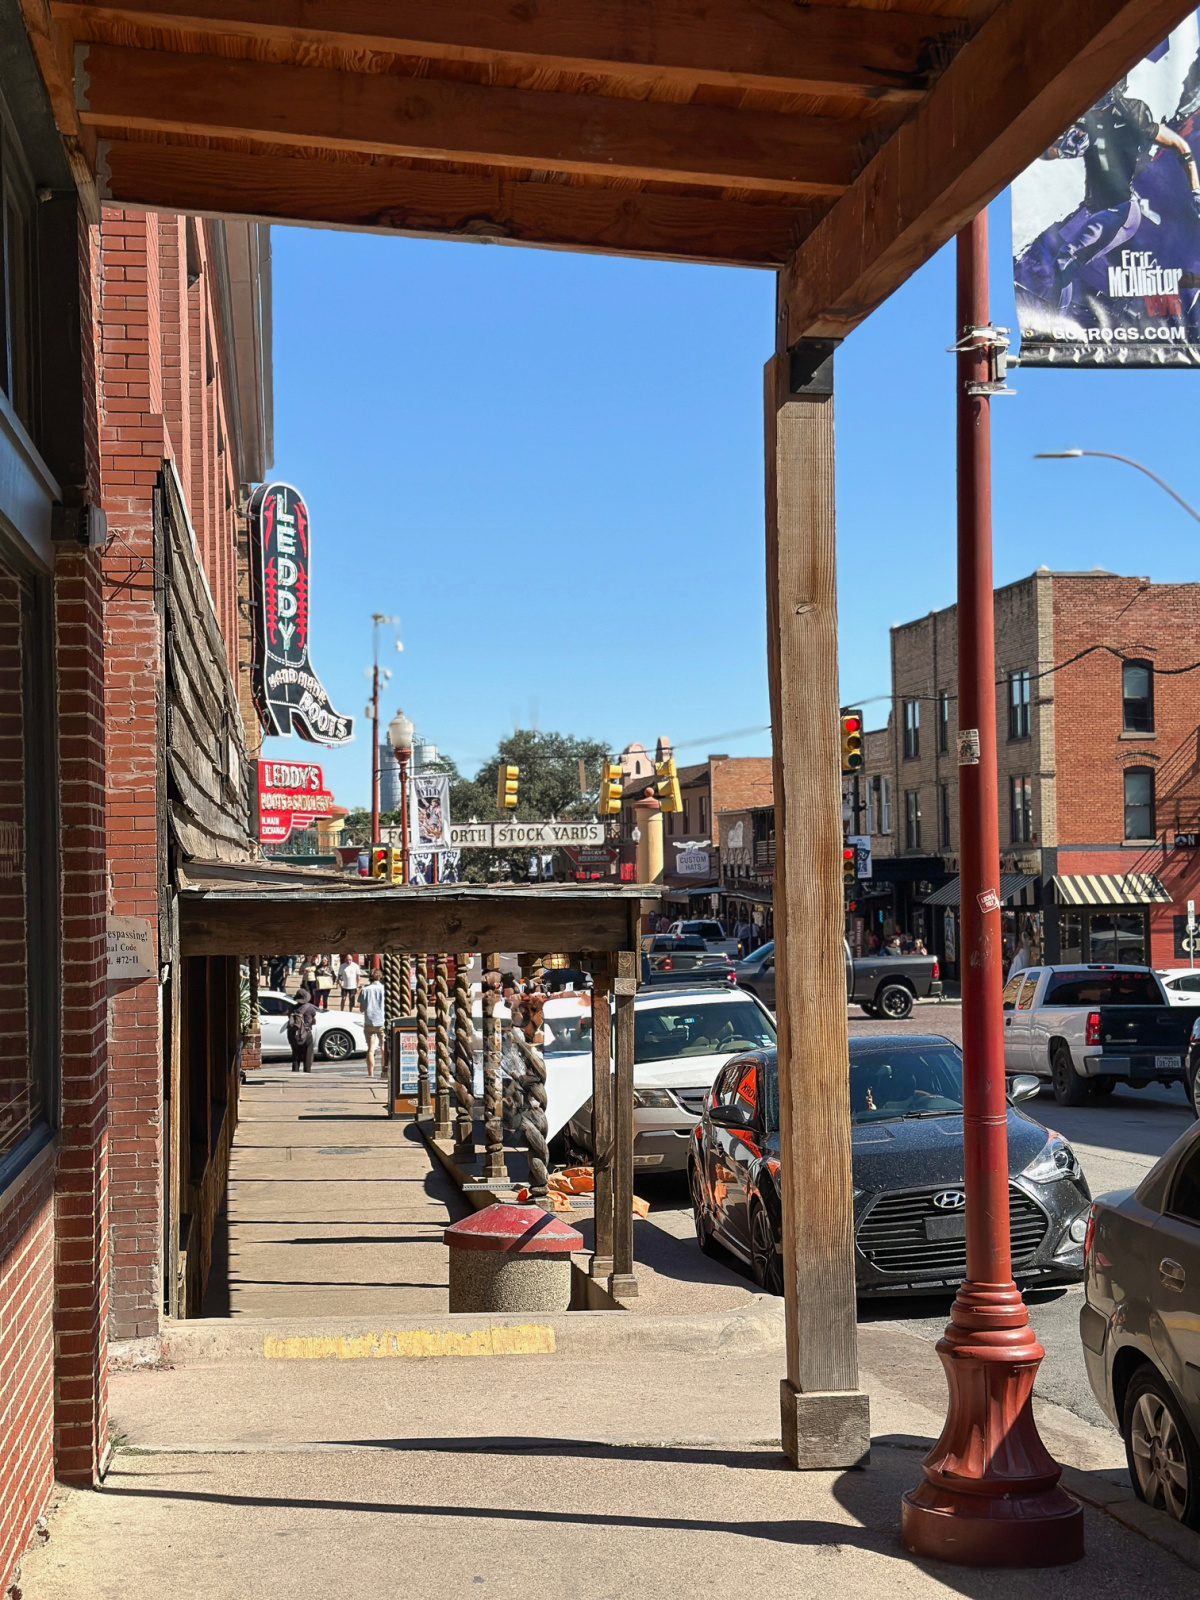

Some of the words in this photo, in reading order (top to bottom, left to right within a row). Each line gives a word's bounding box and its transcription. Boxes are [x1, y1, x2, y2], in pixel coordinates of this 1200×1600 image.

[1122, 250, 1153, 269] Eric
[1108, 265, 1182, 297] McAlister
[276, 494, 297, 650] LEDDY
[299, 690, 347, 738] BOOTS
[264, 764, 319, 791] LEDDY'S
[261, 827, 286, 835] EXCHANGE
[450, 829, 486, 842] ORTH
[499, 828, 545, 841] STOCK
[552, 826, 598, 840] YARDS
[441, 851, 458, 859] TCU
[680, 856, 707, 864] CUSTOM
[106, 930, 148, 942] espassing!
[120, 943, 137, 951] Code
